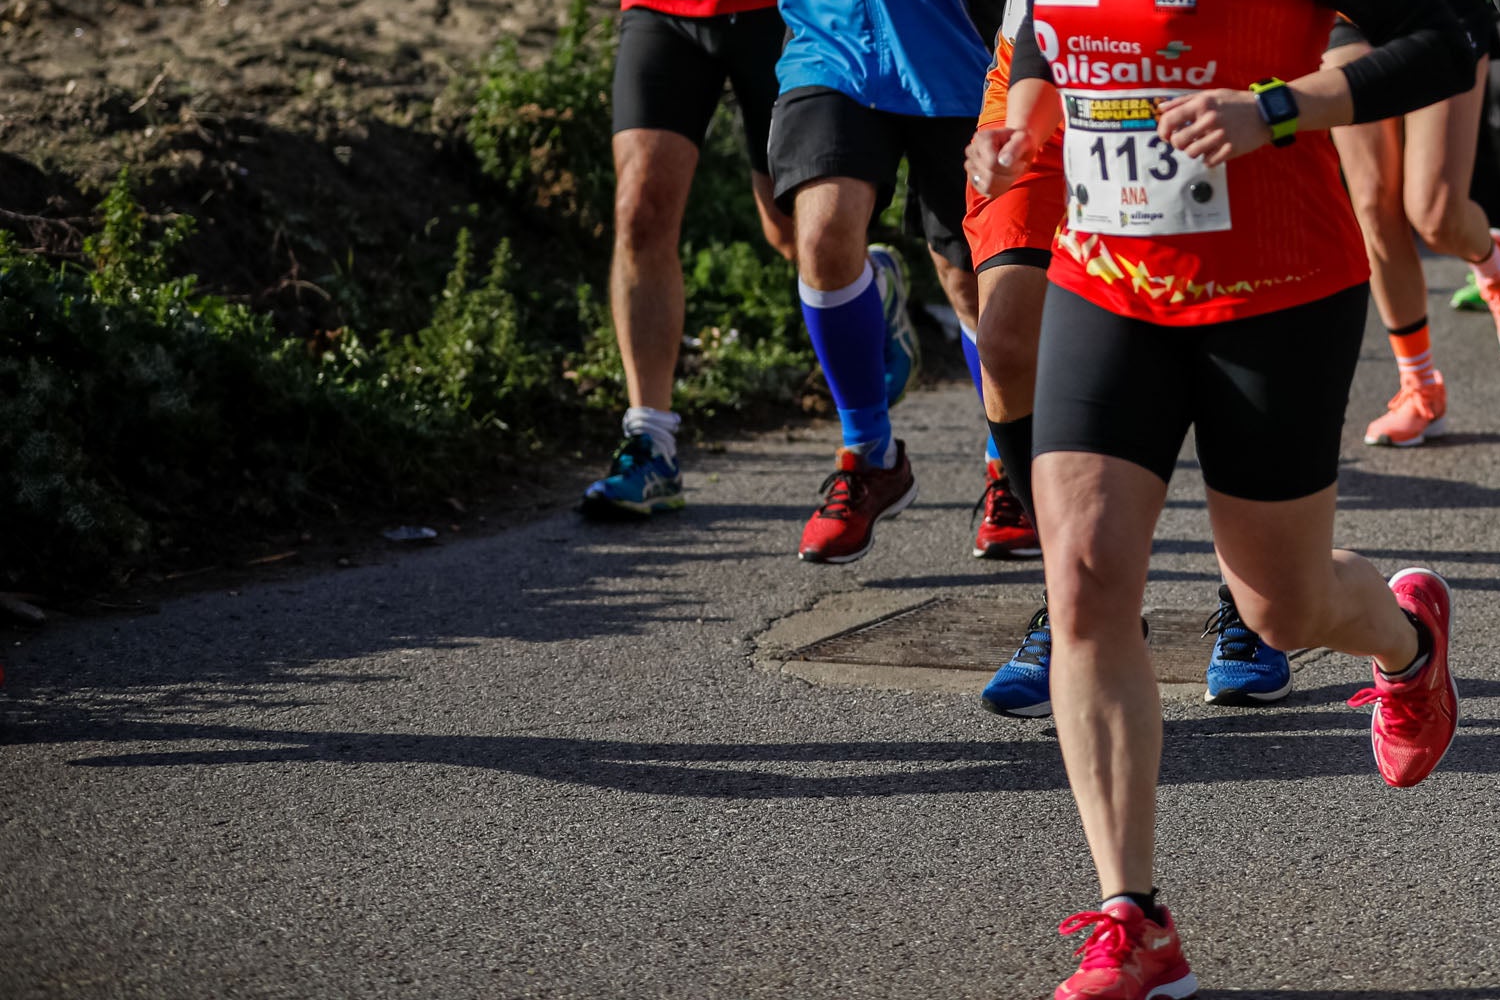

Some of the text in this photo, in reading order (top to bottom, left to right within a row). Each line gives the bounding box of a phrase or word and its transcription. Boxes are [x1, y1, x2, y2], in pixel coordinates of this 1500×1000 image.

[1067, 34, 1142, 55] Clínicas
[1090, 135, 1179, 181] 113
[1120, 187, 1149, 205] ANA
